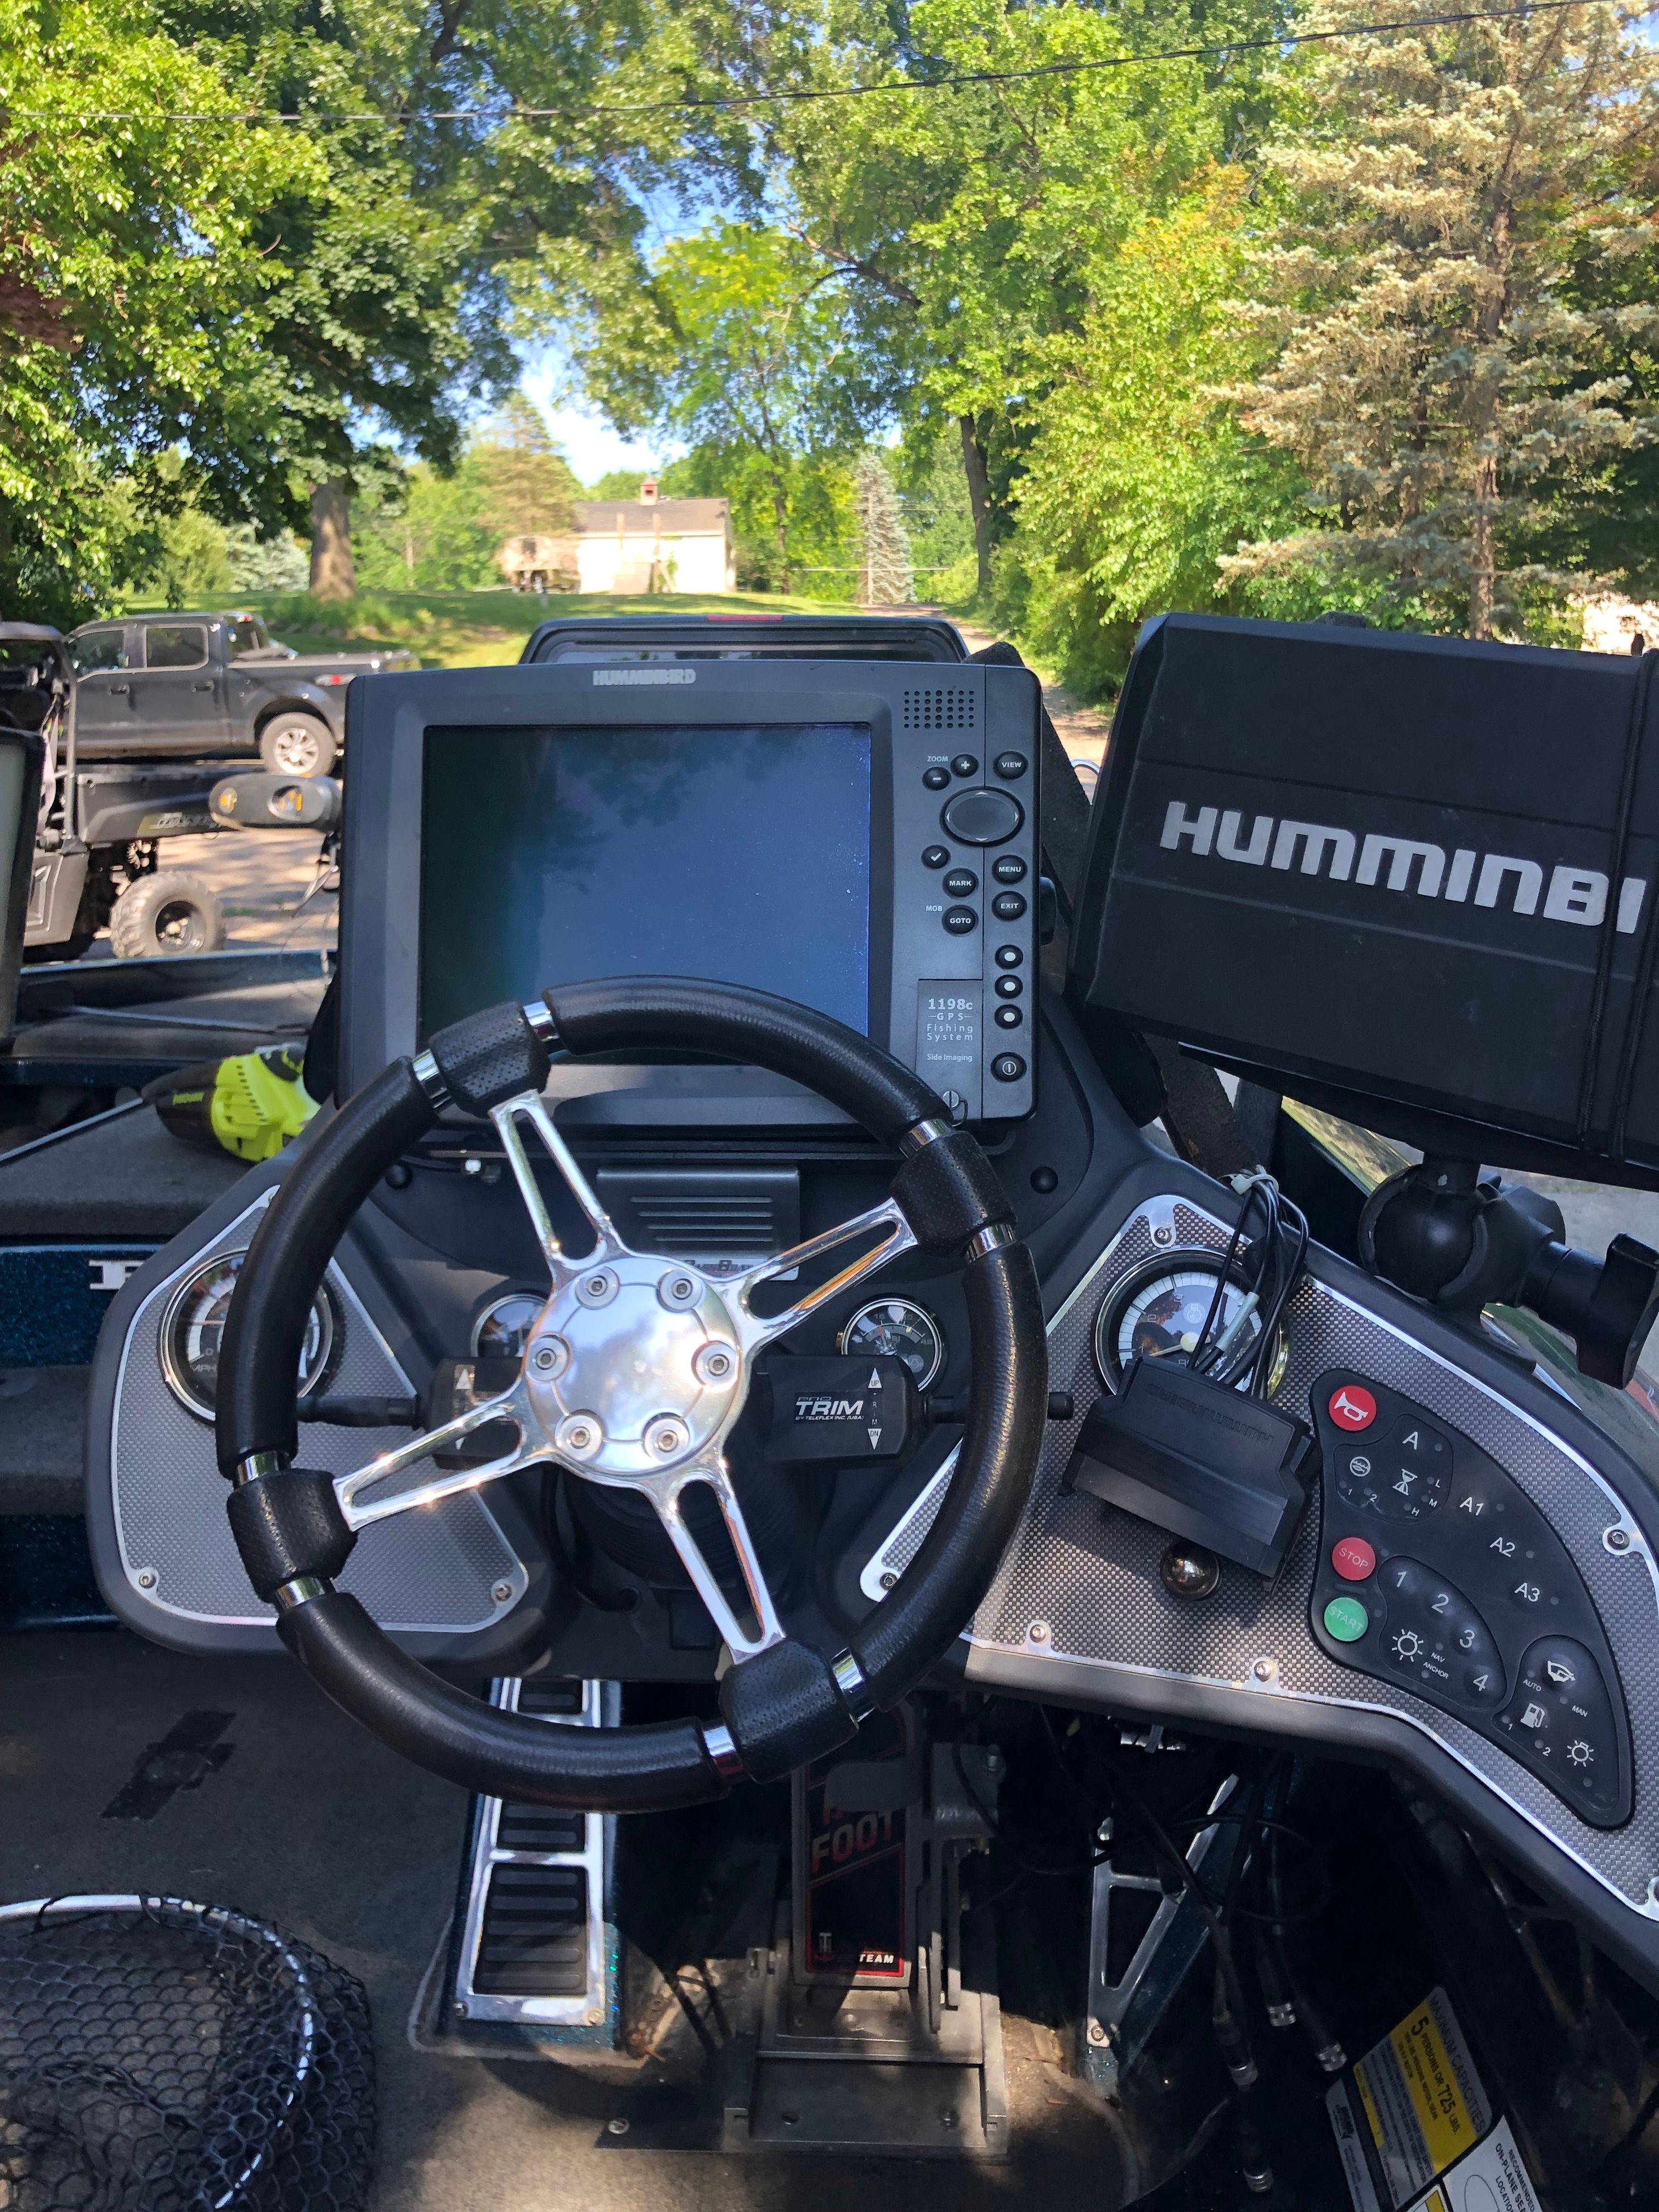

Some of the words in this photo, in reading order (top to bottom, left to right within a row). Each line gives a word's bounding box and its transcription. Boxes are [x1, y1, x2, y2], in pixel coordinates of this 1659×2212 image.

[928, 998, 973, 1011] 1198c
[927, 1024, 973, 1034] Fishing
[927, 1033, 973, 1042] System
[944, 1054, 973, 1063] Imaging
[1147, 1314, 1156, 1323] 2
[795, 1401, 864, 1415] TRIM
[1402, 1431, 1418, 1449] A
[1435, 1480, 1441, 1488] L
[1370, 1494, 1377, 1502] 2
[1429, 1499, 1437, 1508] M
[1459, 1497, 1484, 1516] A1
[1412, 1508, 1420, 1516] H
[1490, 1537, 1516, 1558] A2
[1339, 1547, 1368, 1568] STOP
[1397, 1571, 1407, 1588] 1
[1514, 1582, 1540, 1602] A3
[1431, 1594, 1449, 1613] 2
[1328, 1606, 1364, 1632] START
[1460, 1629, 1475, 1648] 3
[1431, 1651, 1445, 1663] NAV
[1423, 1662, 1449, 1679] ANCHOR
[1473, 1674, 1488, 1691] 4
[1523, 1679, 1542, 1692] AUTO
[1571, 1705, 1588, 1718] MAN
[1543, 1747, 1551, 1757] 2
[811, 1810, 893, 1875] FOOT
[860, 1954, 894, 1964] TEAM
[1410, 2016, 1430, 2036] 5
[1420, 2032, 1439, 2073] PERSONS
[1429, 1995, 1458, 2055] MAXIMUM
[1452, 2053, 1487, 2132] CAPACITIES
[1434, 2072, 1444, 2086] OR
[1437, 2084, 1457, 2114] 725
[1496, 2143, 1518, 2194] ON-PLANE
[1509, 2149, 1534, 2212] RECOMMENDED
[1496, 2175, 1514, 2212] LOCATIO
